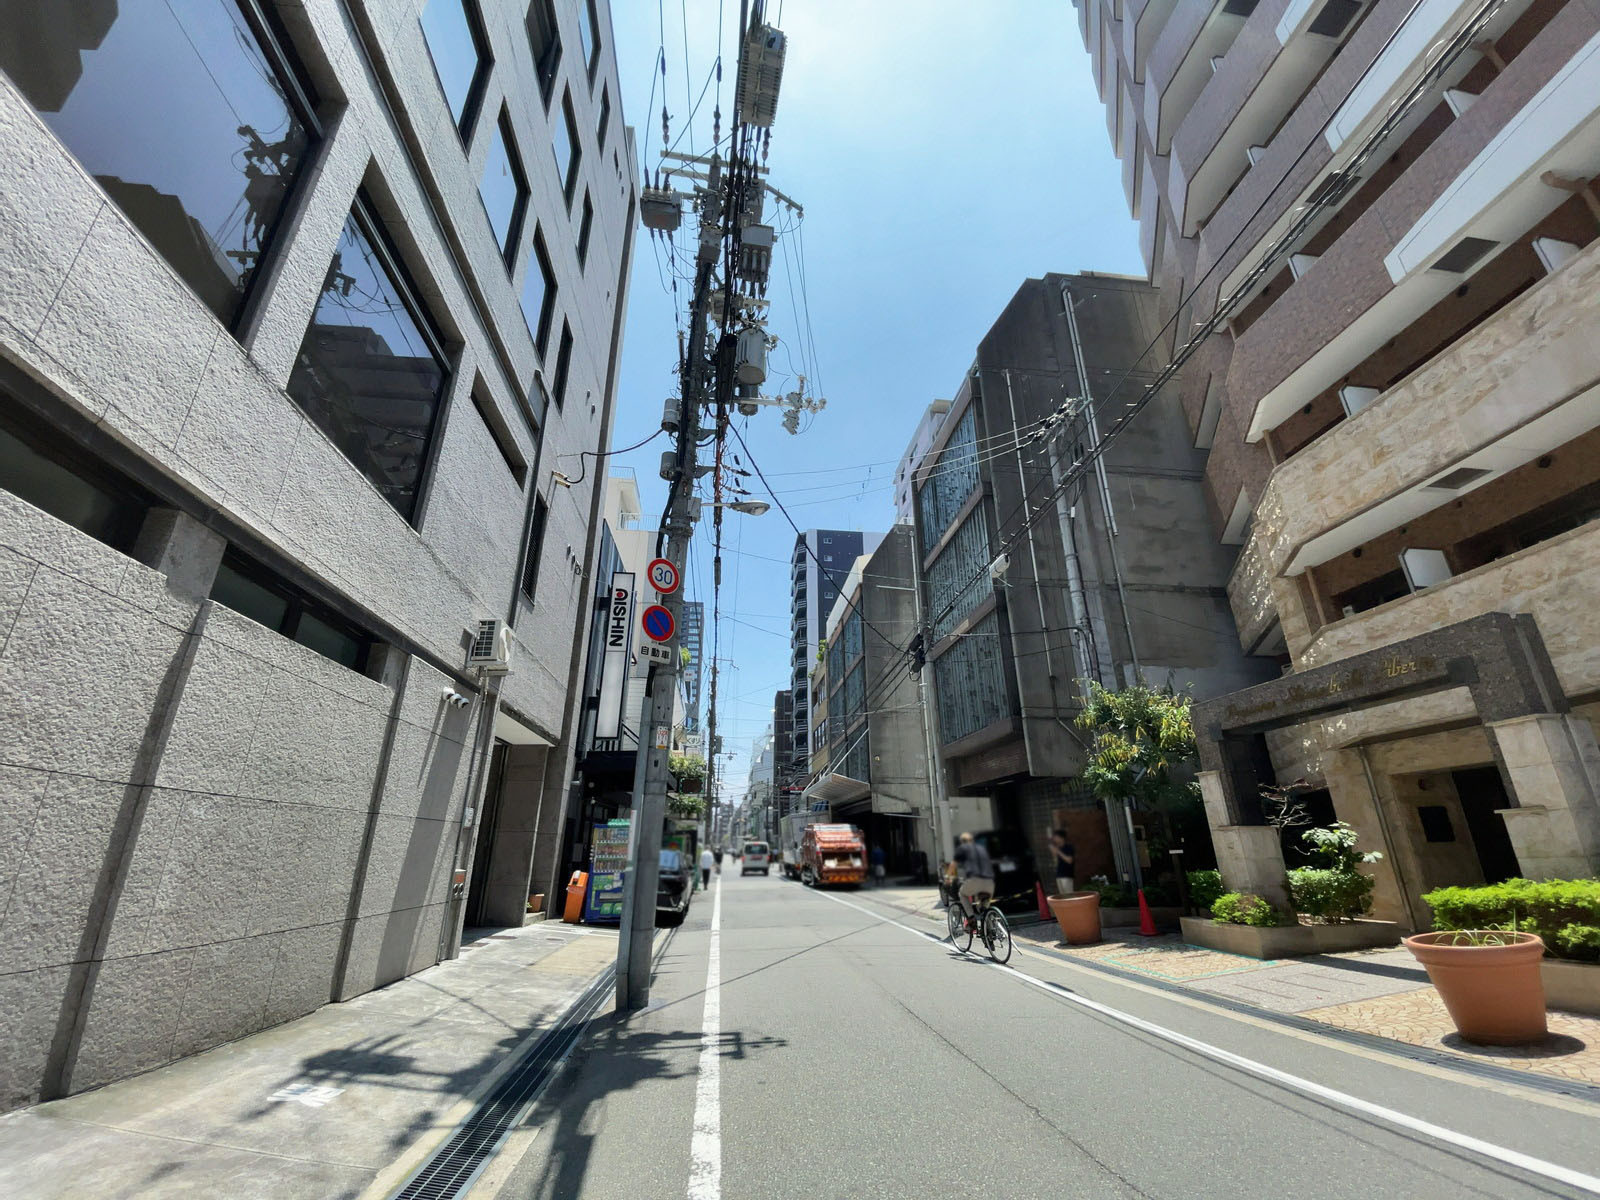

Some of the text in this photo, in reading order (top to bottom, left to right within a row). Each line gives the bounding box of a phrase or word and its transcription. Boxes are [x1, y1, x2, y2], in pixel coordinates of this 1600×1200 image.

[655, 567, 673, 585] 30
[640, 645, 670, 660] 自動車
